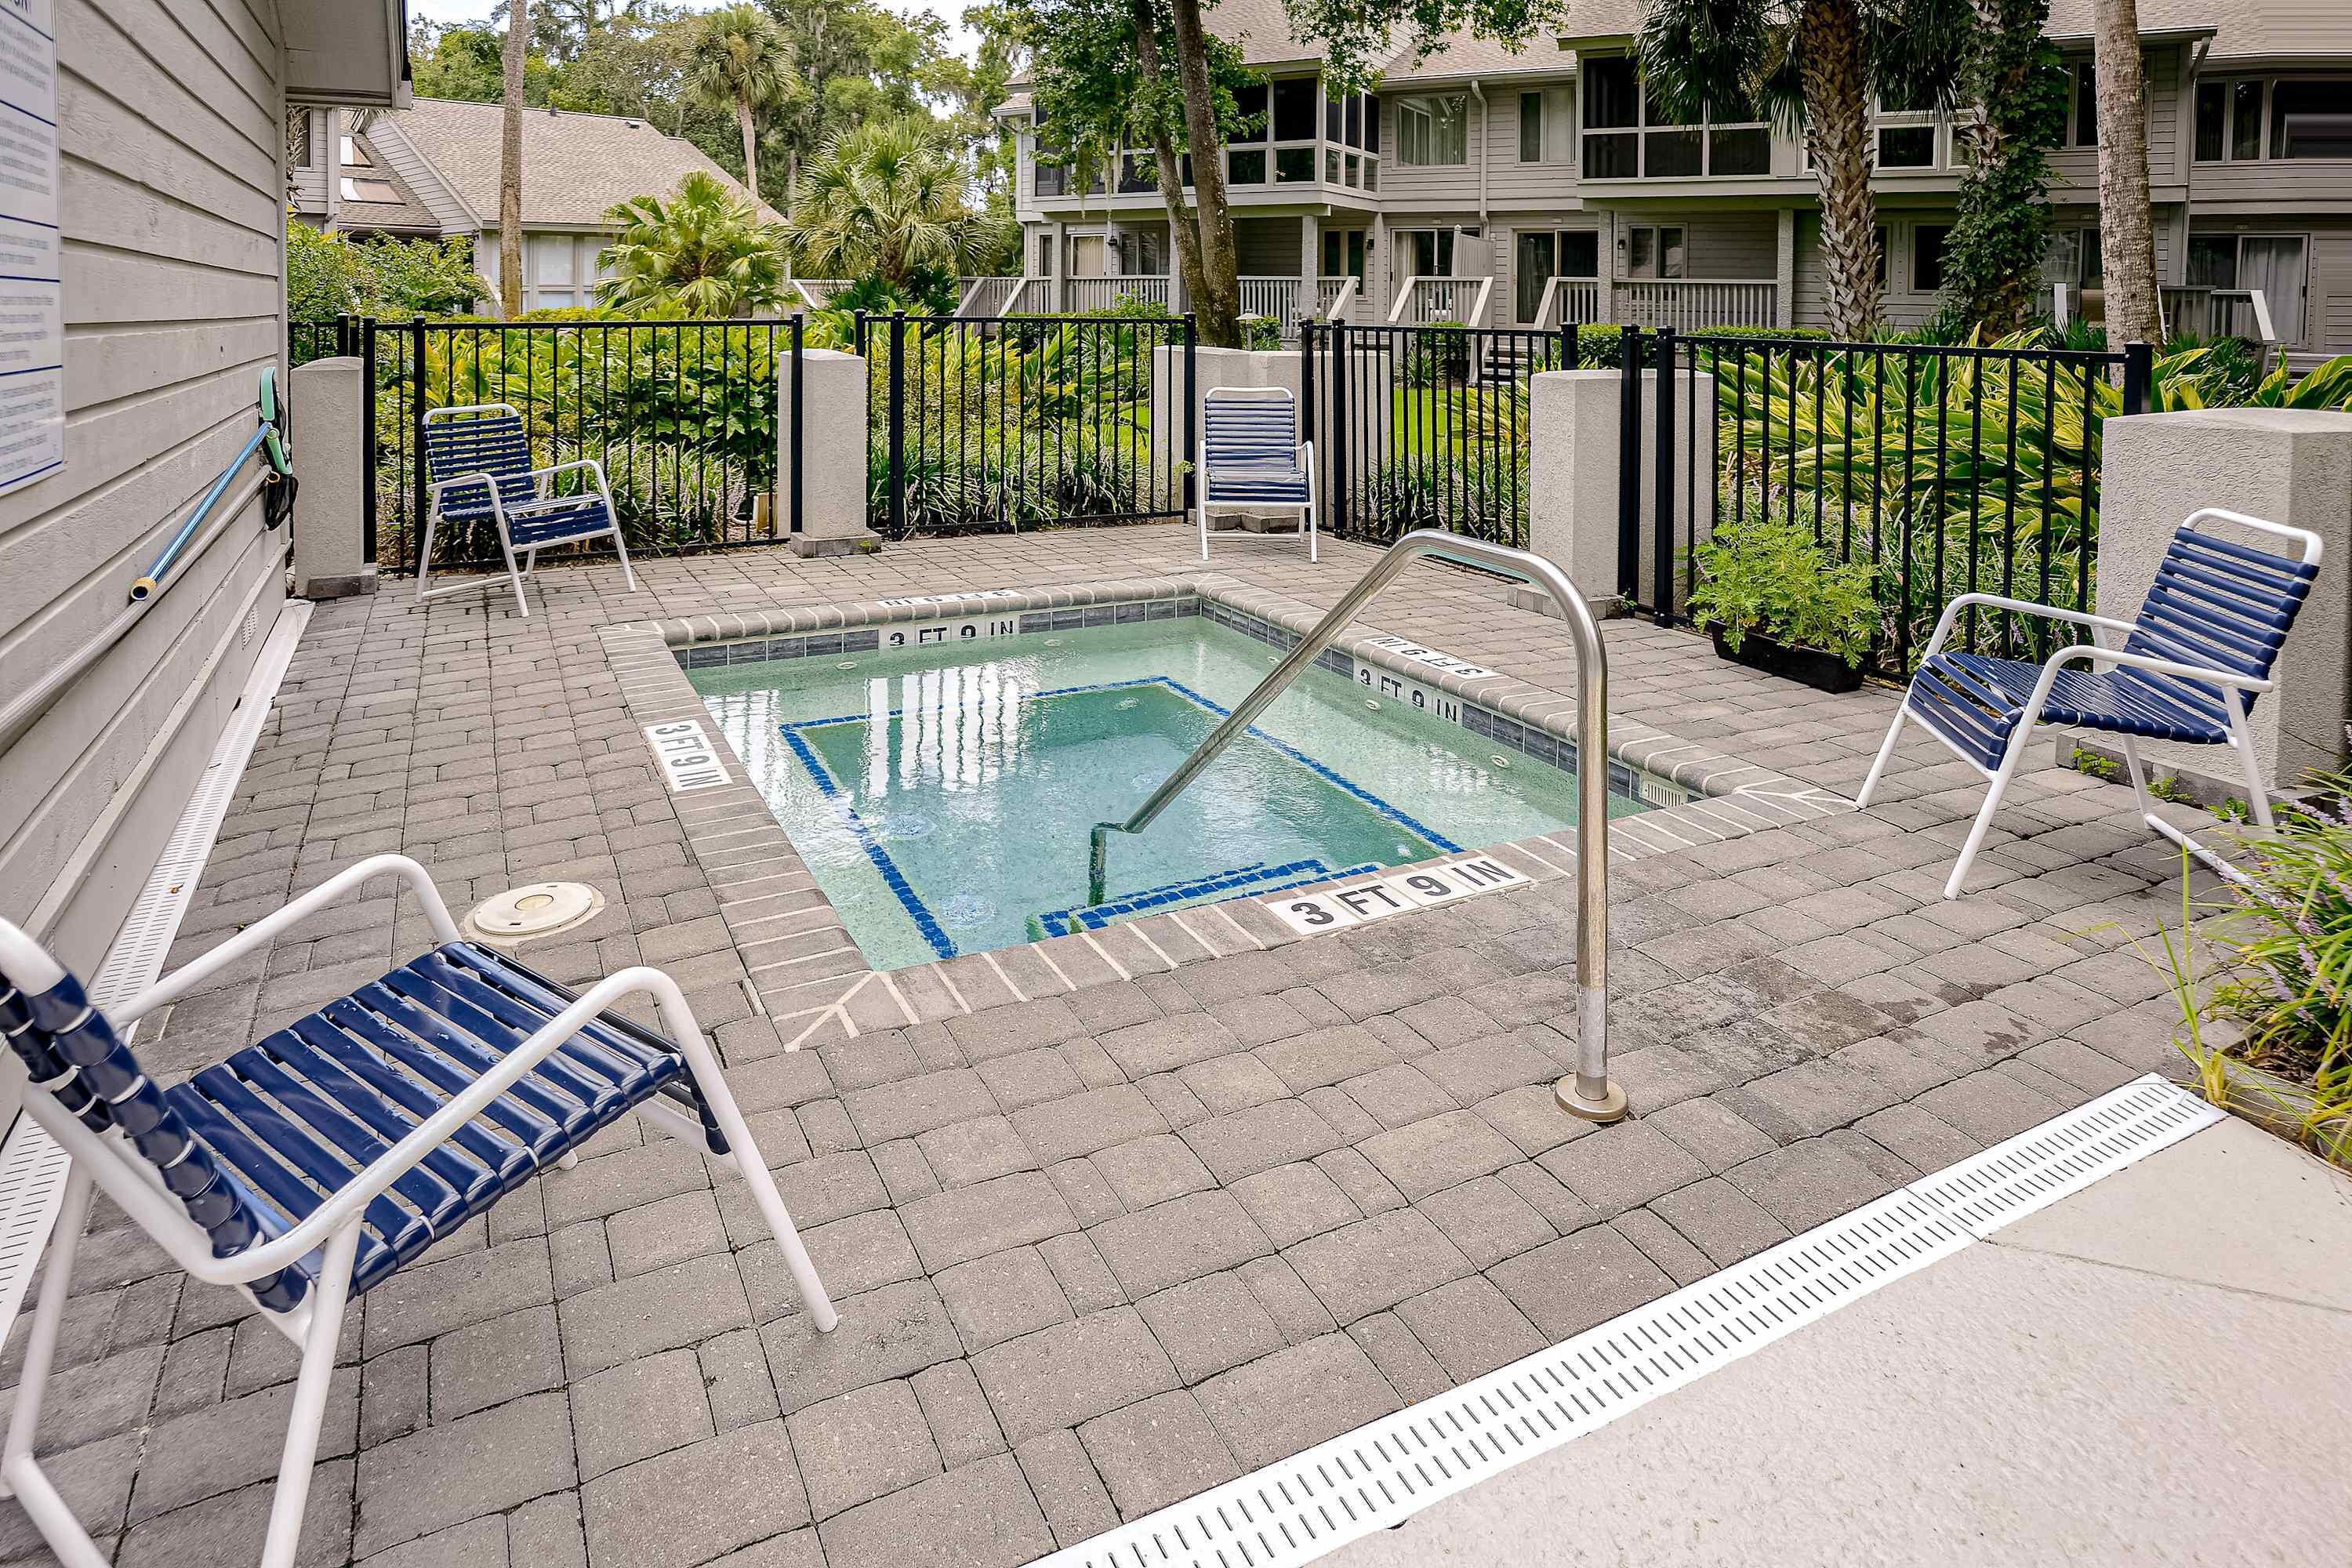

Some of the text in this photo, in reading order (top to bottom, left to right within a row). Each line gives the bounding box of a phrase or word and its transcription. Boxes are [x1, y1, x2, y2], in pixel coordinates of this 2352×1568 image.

[919, 626, 947, 644] FT
[990, 621, 1013, 636] IN
[1372, 637, 1408, 648] IN
[1421, 658, 1462, 667] FT
[1360, 669, 1371, 685] 3
[1381, 676, 1402, 698] FT
[1436, 698, 1457, 722] IN
[655, 724, 723, 787] 3 FT 9 IN
[1290, 861, 1515, 925] 3 FT 9 IN
